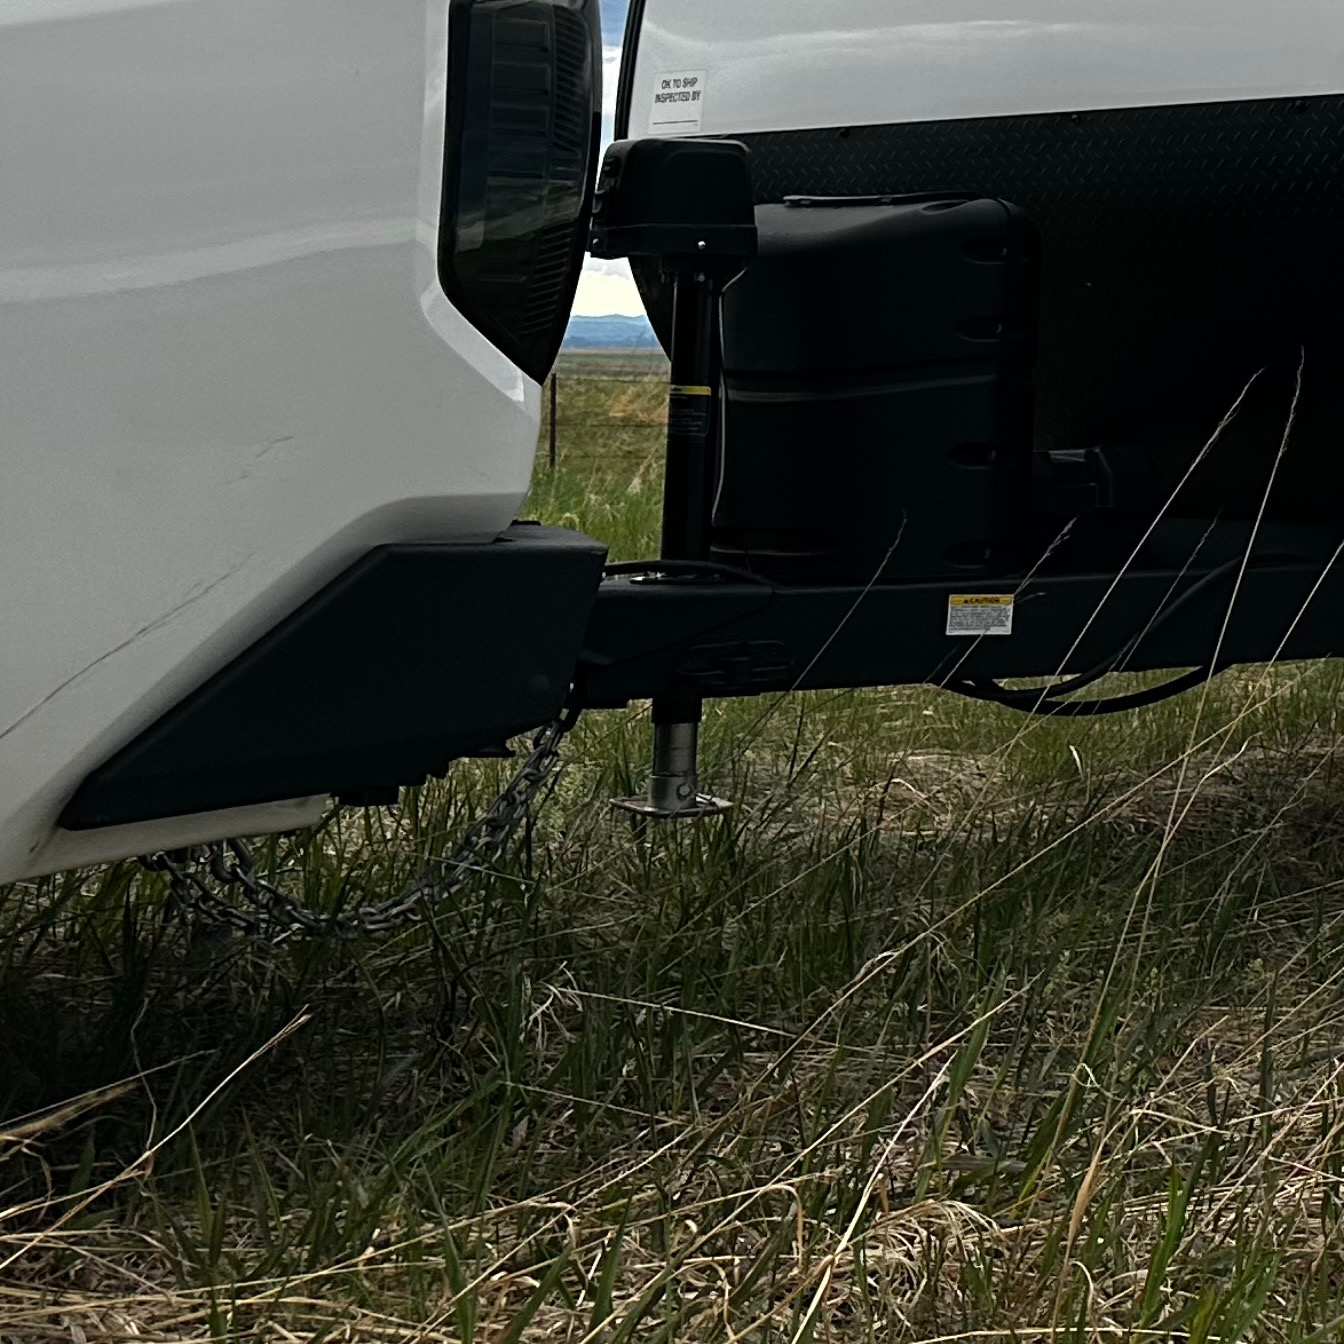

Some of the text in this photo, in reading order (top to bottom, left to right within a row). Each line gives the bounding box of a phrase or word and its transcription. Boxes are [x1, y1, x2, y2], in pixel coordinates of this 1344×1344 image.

[661, 77, 698, 89] OK TO SHIP
[655, 90, 701, 103] INSPECTED BY
